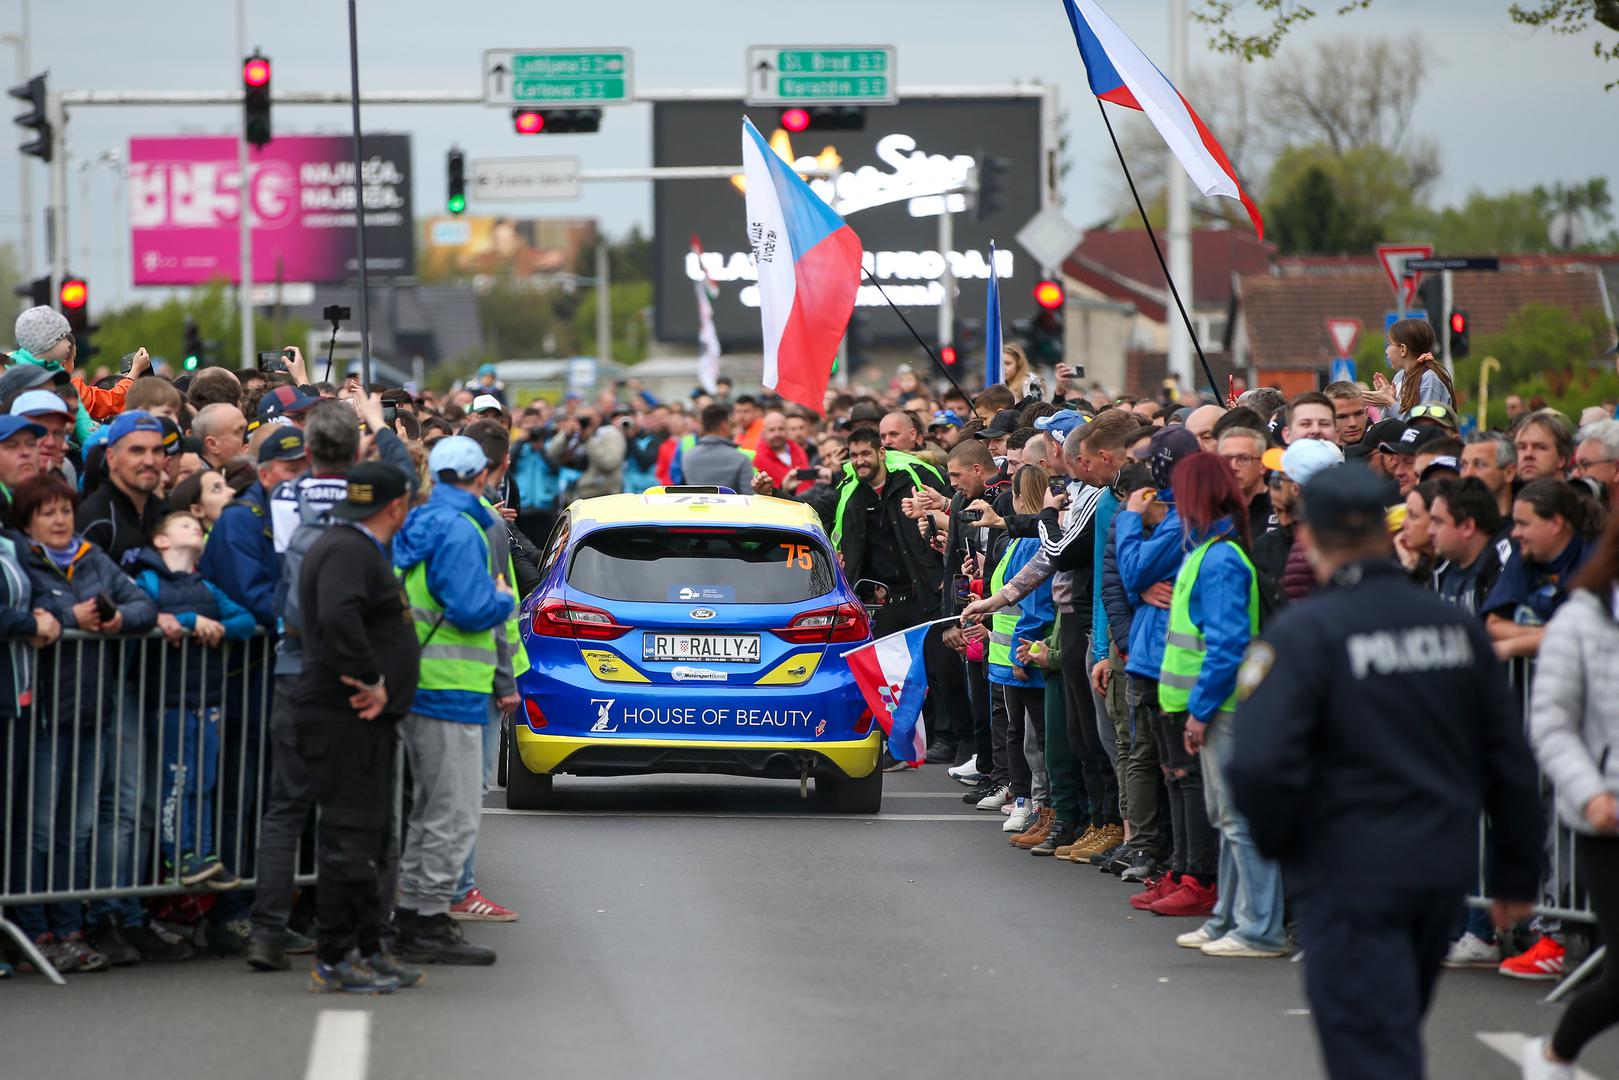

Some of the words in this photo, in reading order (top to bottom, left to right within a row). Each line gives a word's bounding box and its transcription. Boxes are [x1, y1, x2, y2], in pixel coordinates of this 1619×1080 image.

[779, 543, 814, 571] 75
[656, 637, 676, 655] RI
[623, 708, 697, 725] HOUSE
[701, 708, 730, 726] OF
[736, 709, 813, 727] BEAUTY
